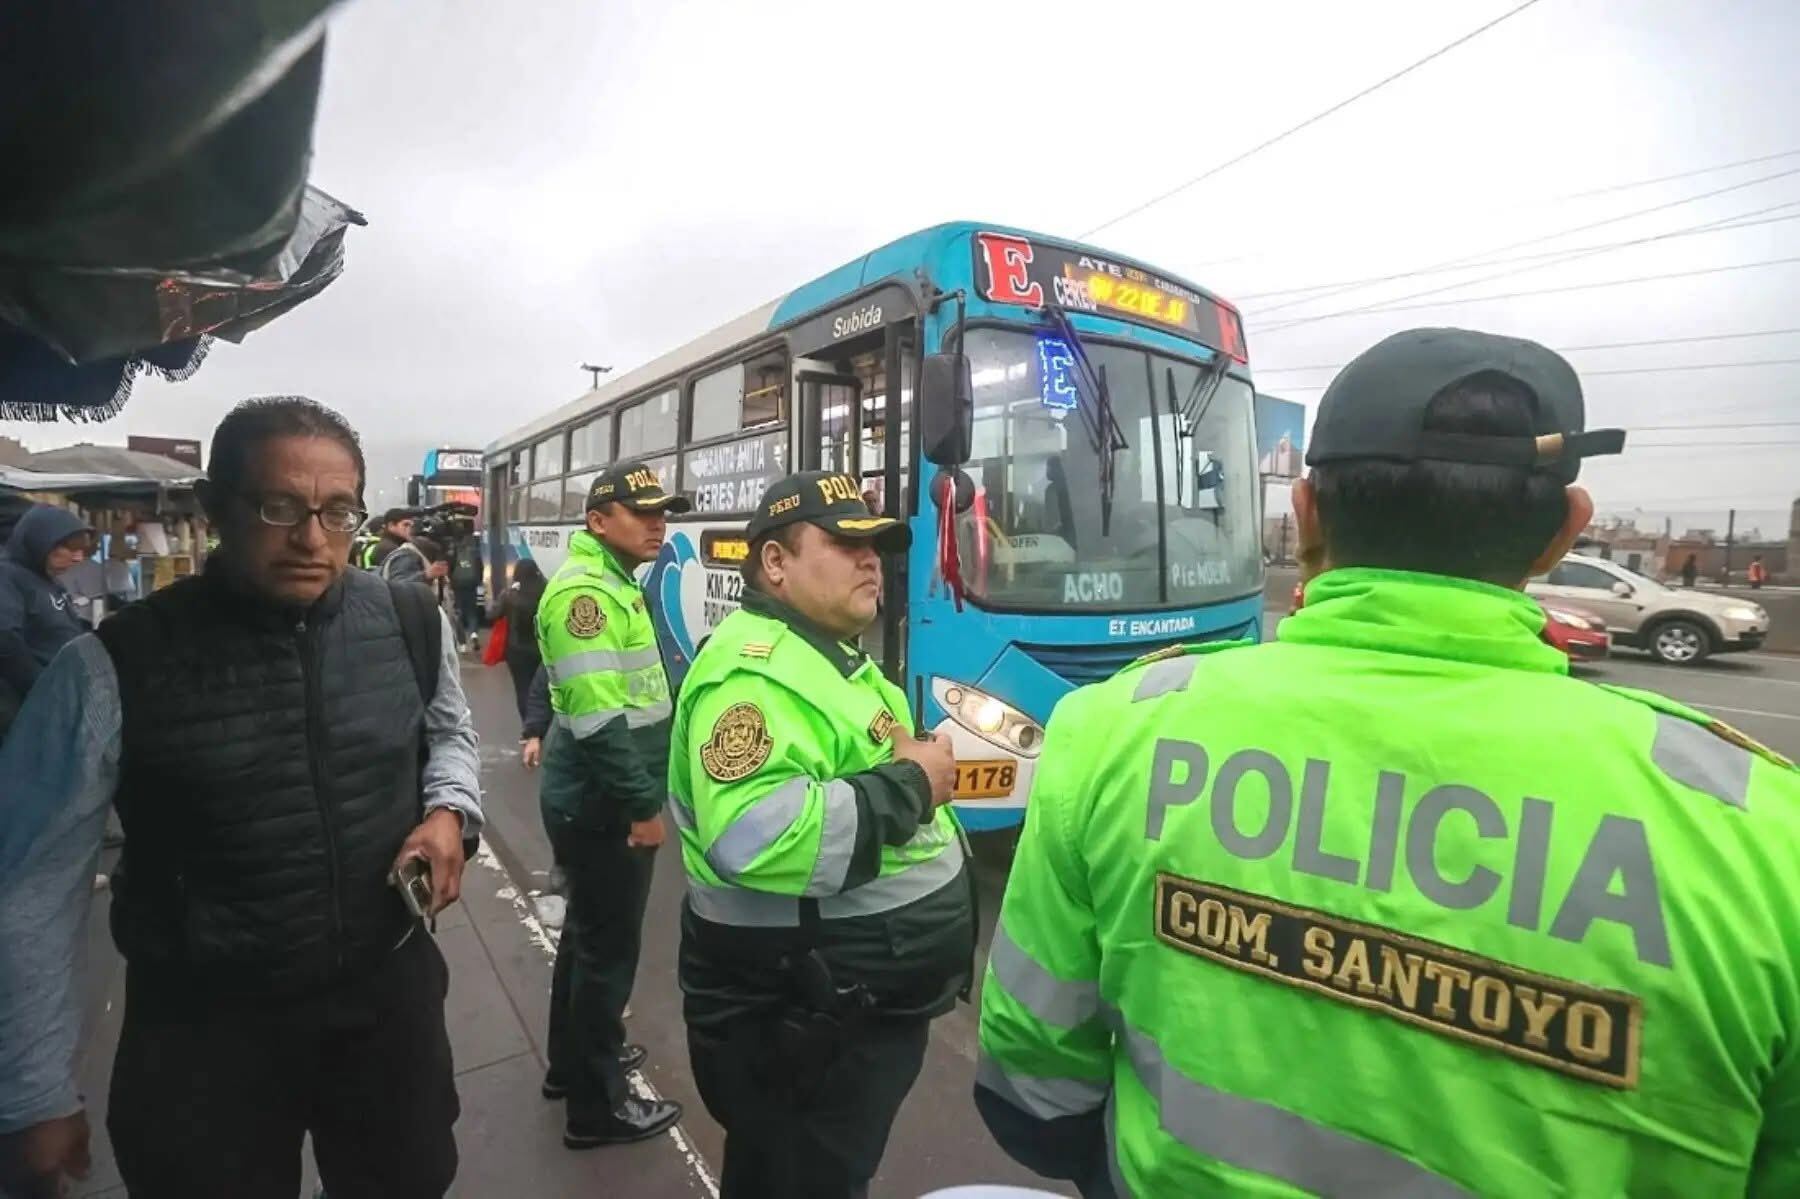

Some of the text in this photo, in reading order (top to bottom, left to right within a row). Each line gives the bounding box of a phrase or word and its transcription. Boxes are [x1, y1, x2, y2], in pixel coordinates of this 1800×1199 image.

[979, 232, 1043, 309] E
[1079, 256, 1122, 277] ATE
[1117, 285, 1139, 309] 22
[833, 304, 882, 338] Subida
[1038, 339, 1077, 409] E
[695, 478, 765, 513] CERES ATE
[769, 494, 800, 517] PERU
[1064, 572, 1123, 603] ACHO
[1130, 616, 1195, 637] ENCANTADA
[1145, 738, 1673, 970] POLICIA
[1169, 891, 1613, 1063] COM. SANTOYO
